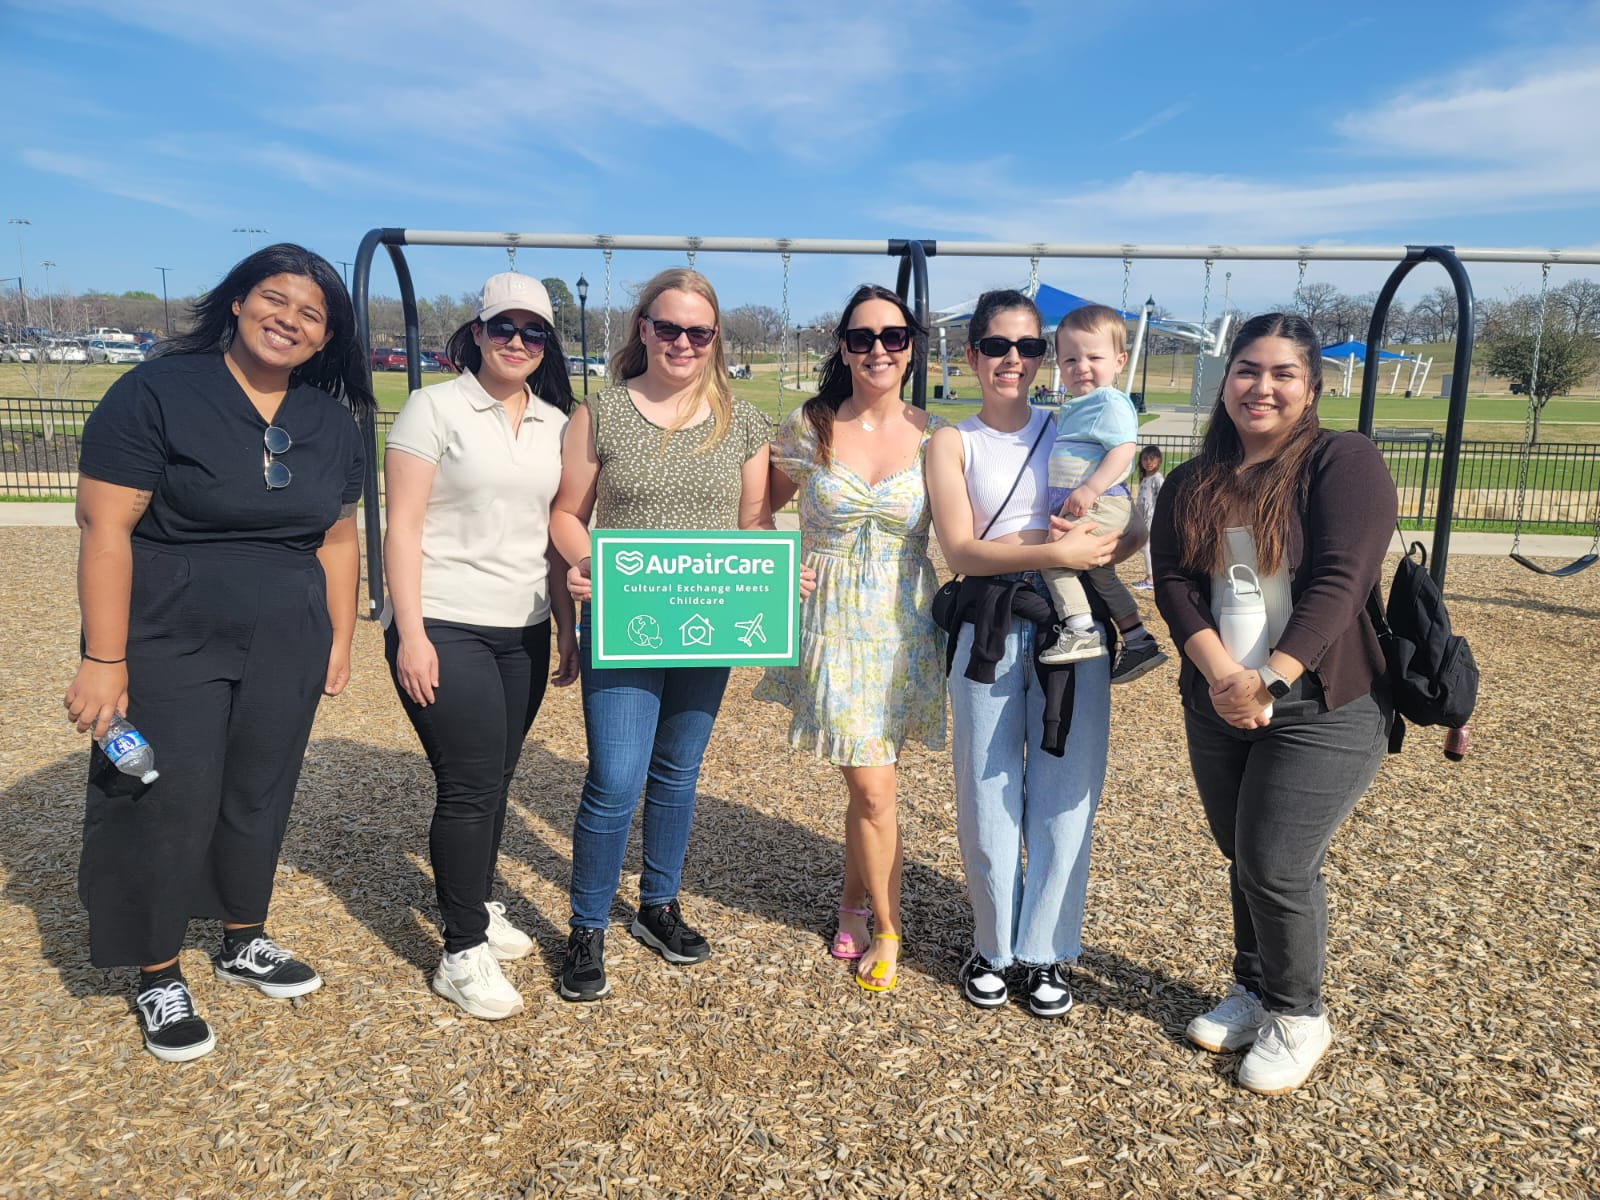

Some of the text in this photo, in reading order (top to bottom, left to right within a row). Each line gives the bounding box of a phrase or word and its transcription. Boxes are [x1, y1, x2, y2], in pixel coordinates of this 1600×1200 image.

[645, 553, 775, 575] AuPairCare
[623, 584, 770, 595] Cultural Exchange Meets
[669, 596, 725, 605] Childcare
